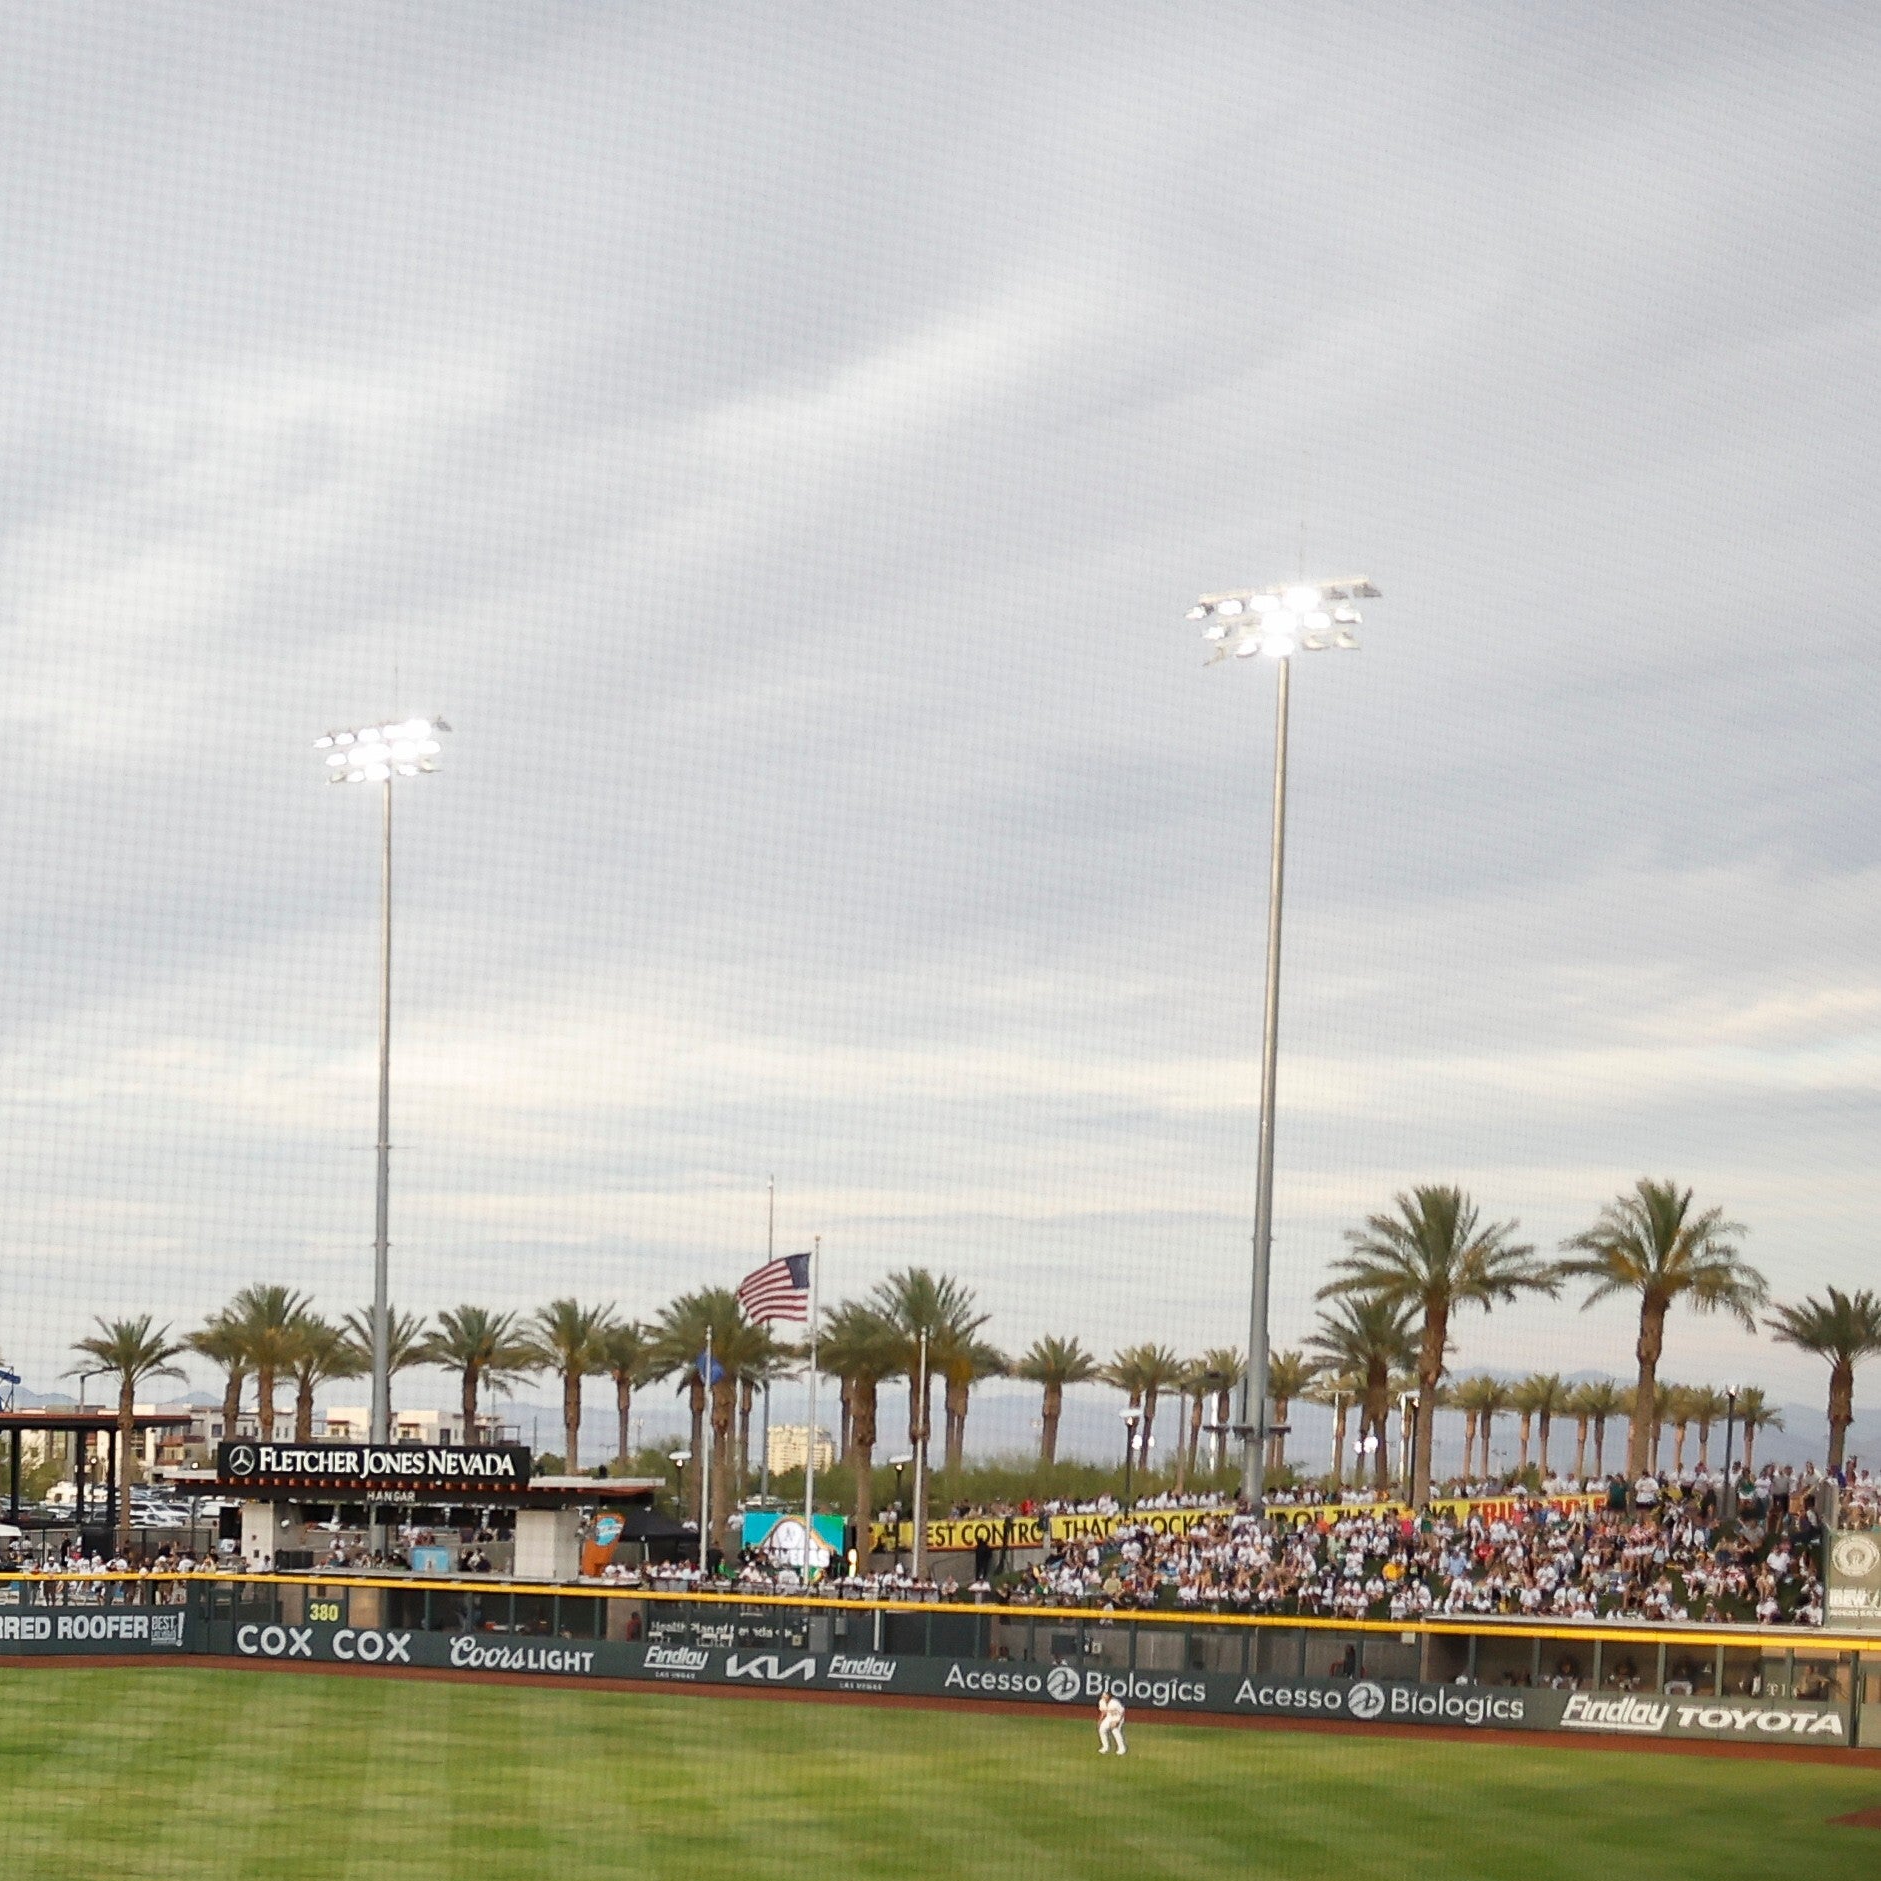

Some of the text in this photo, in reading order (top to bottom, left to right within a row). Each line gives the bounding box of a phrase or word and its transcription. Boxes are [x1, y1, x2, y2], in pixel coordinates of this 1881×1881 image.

[259, 1446, 516, 1479] FLETCHER JONES NEVADA
[366, 1490, 416, 1502] HANGAR
[961, 1521, 1044, 1547] CONTRO
[58, 1615, 150, 1640] ROOFER
[309, 1603, 339, 1622] 380
[237, 1625, 313, 1657] COX
[332, 1630, 412, 1663] COX
[449, 1635, 594, 1673] Coors LIGHT
[645, 1645, 709, 1667] Findlay
[828, 1654, 896, 1678] Findlay
[944, 1663, 1206, 1707] Acesso Biologics
[1234, 1677, 1525, 1725] Acesso Biologics
[1561, 1693, 1844, 1736] Findlay TOYOTA
